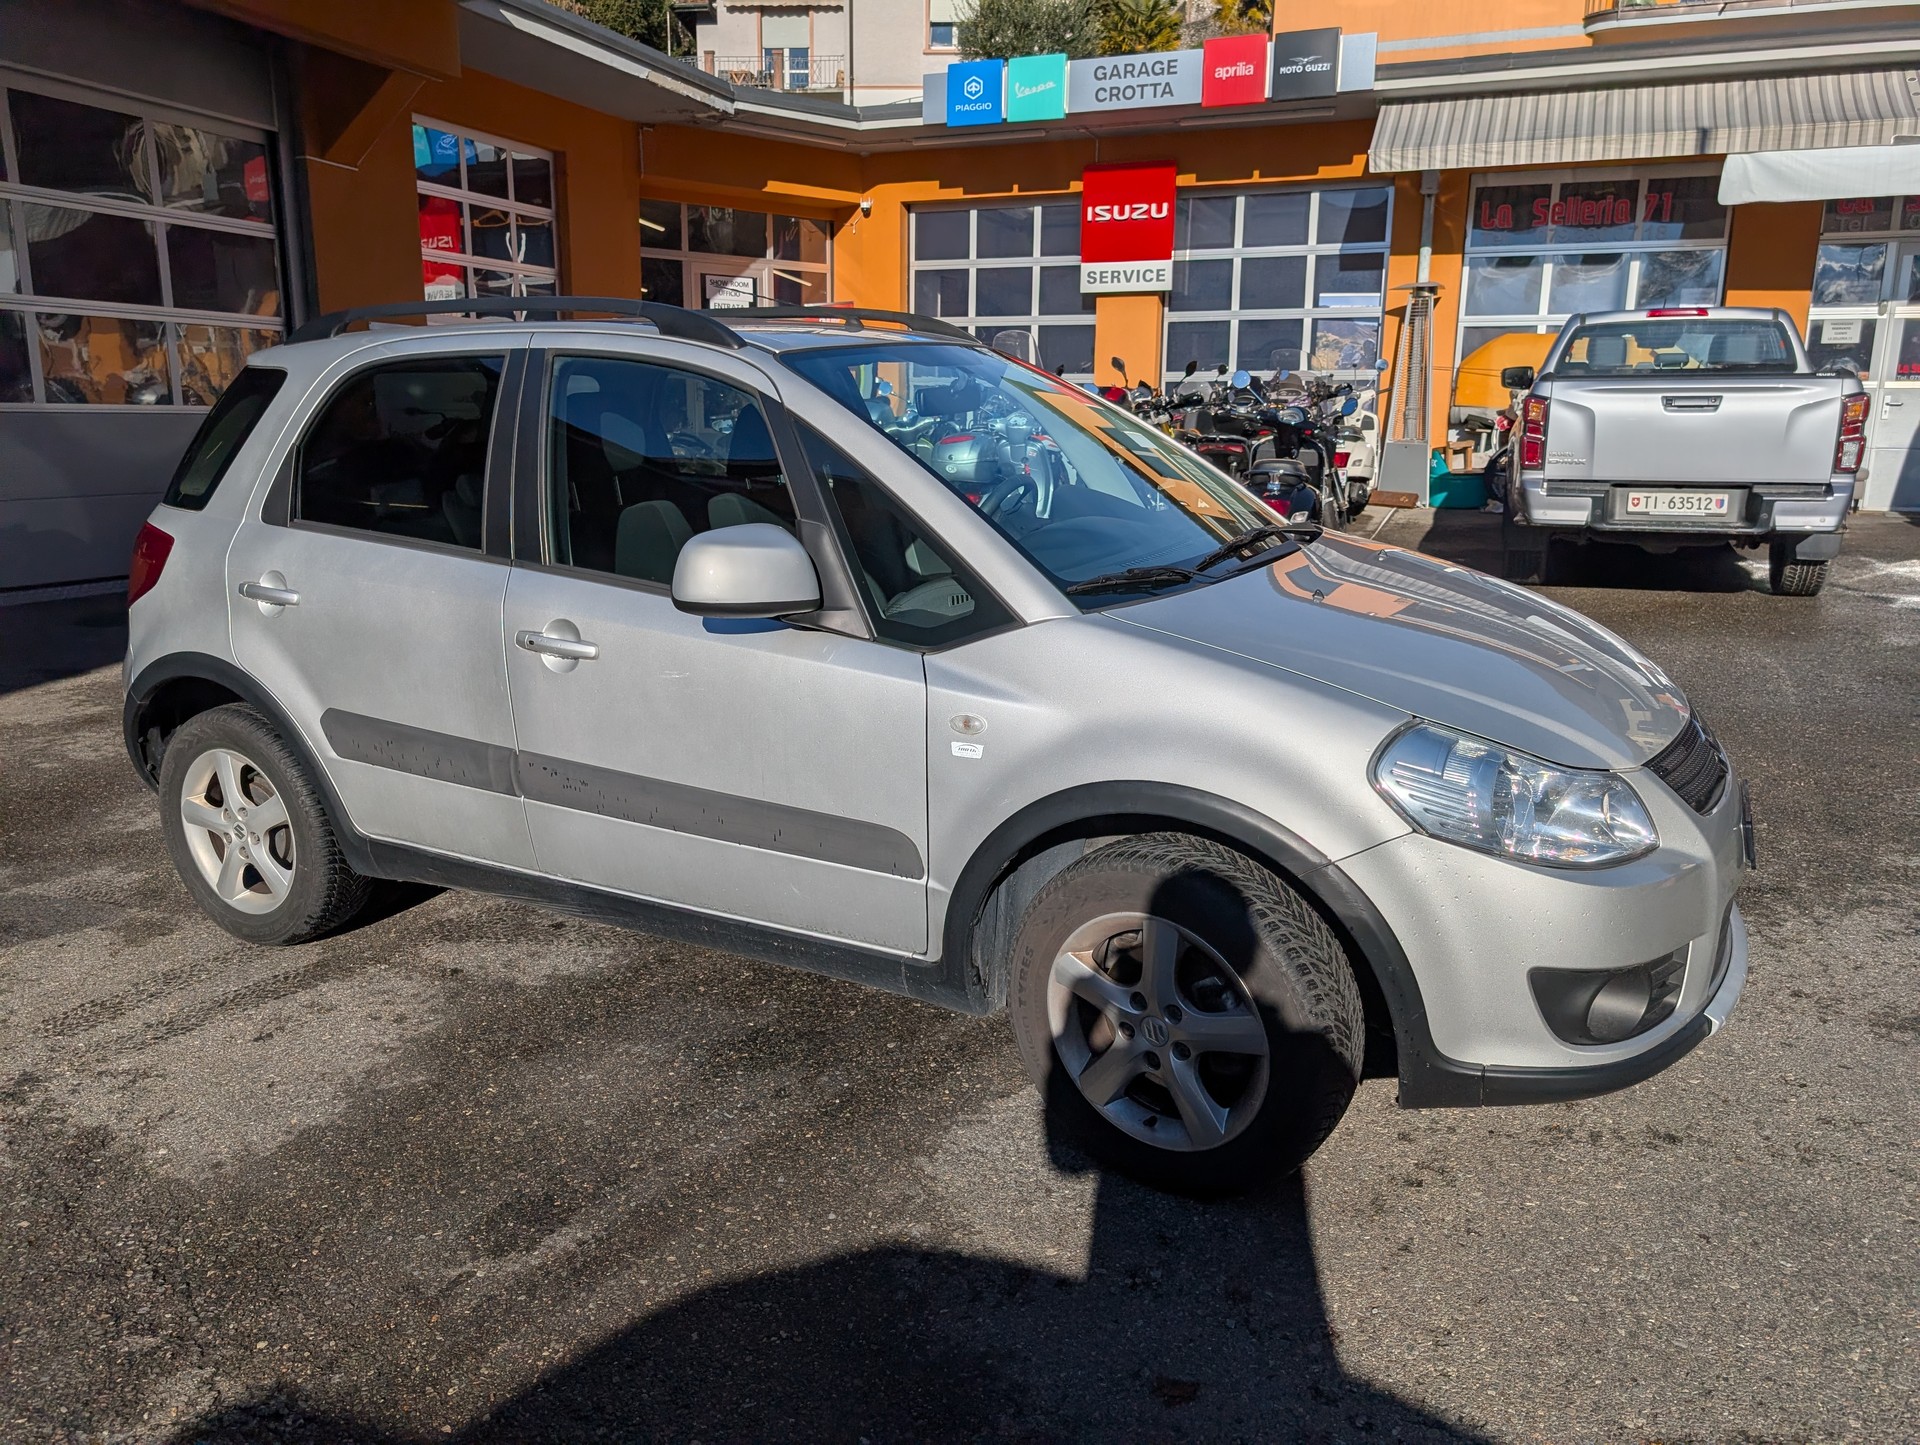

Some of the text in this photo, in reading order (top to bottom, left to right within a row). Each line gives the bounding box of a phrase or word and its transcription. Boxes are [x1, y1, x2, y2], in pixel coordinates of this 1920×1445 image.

[1093, 59, 1178, 82] GARAGE
[1214, 62, 1254, 80] aprilia
[1279, 63, 1331, 75] MOTO GUZZI
[1014, 82, 1057, 99] Vespa
[1095, 82, 1174, 103] CROTTA
[955, 101, 992, 113] PIAGGIO
[1086, 202, 1170, 222] ISUZU
[1480, 192, 1673, 230] La Selleria 71
[709, 278, 749, 288] SHOW ROOM
[1086, 267, 1167, 285] SERVICE
[718, 289, 741, 298] UFFICIO
[1018, 945, 1034, 1009] TYRES
